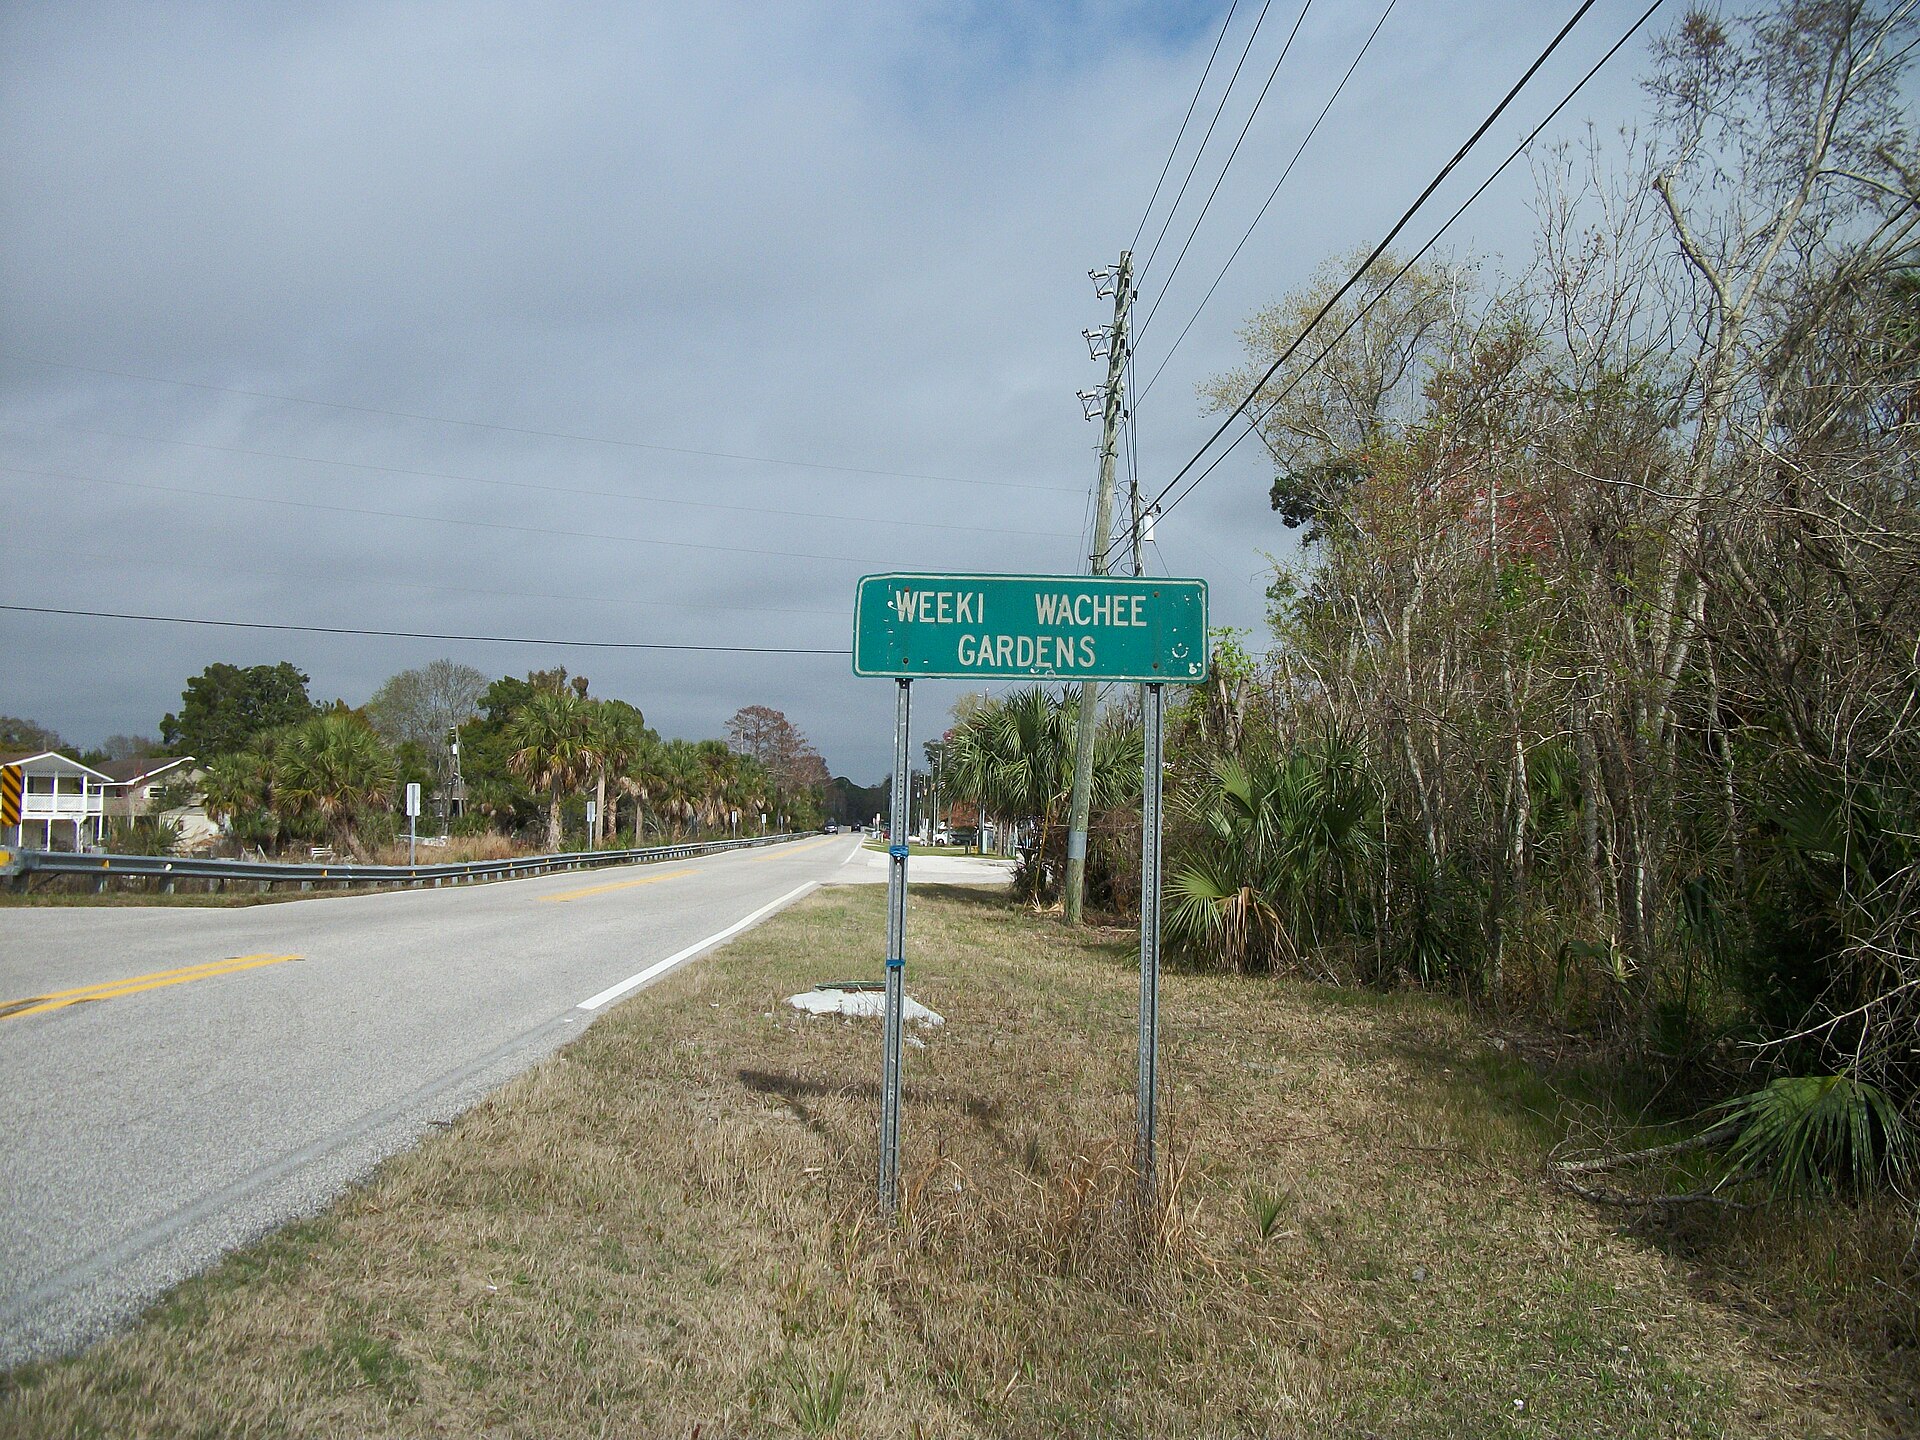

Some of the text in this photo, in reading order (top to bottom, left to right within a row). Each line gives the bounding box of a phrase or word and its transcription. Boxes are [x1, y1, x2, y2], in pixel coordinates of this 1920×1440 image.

[896, 590, 1147, 627] WEEKI WACHEE
[958, 634, 1096, 668] GARDENS
